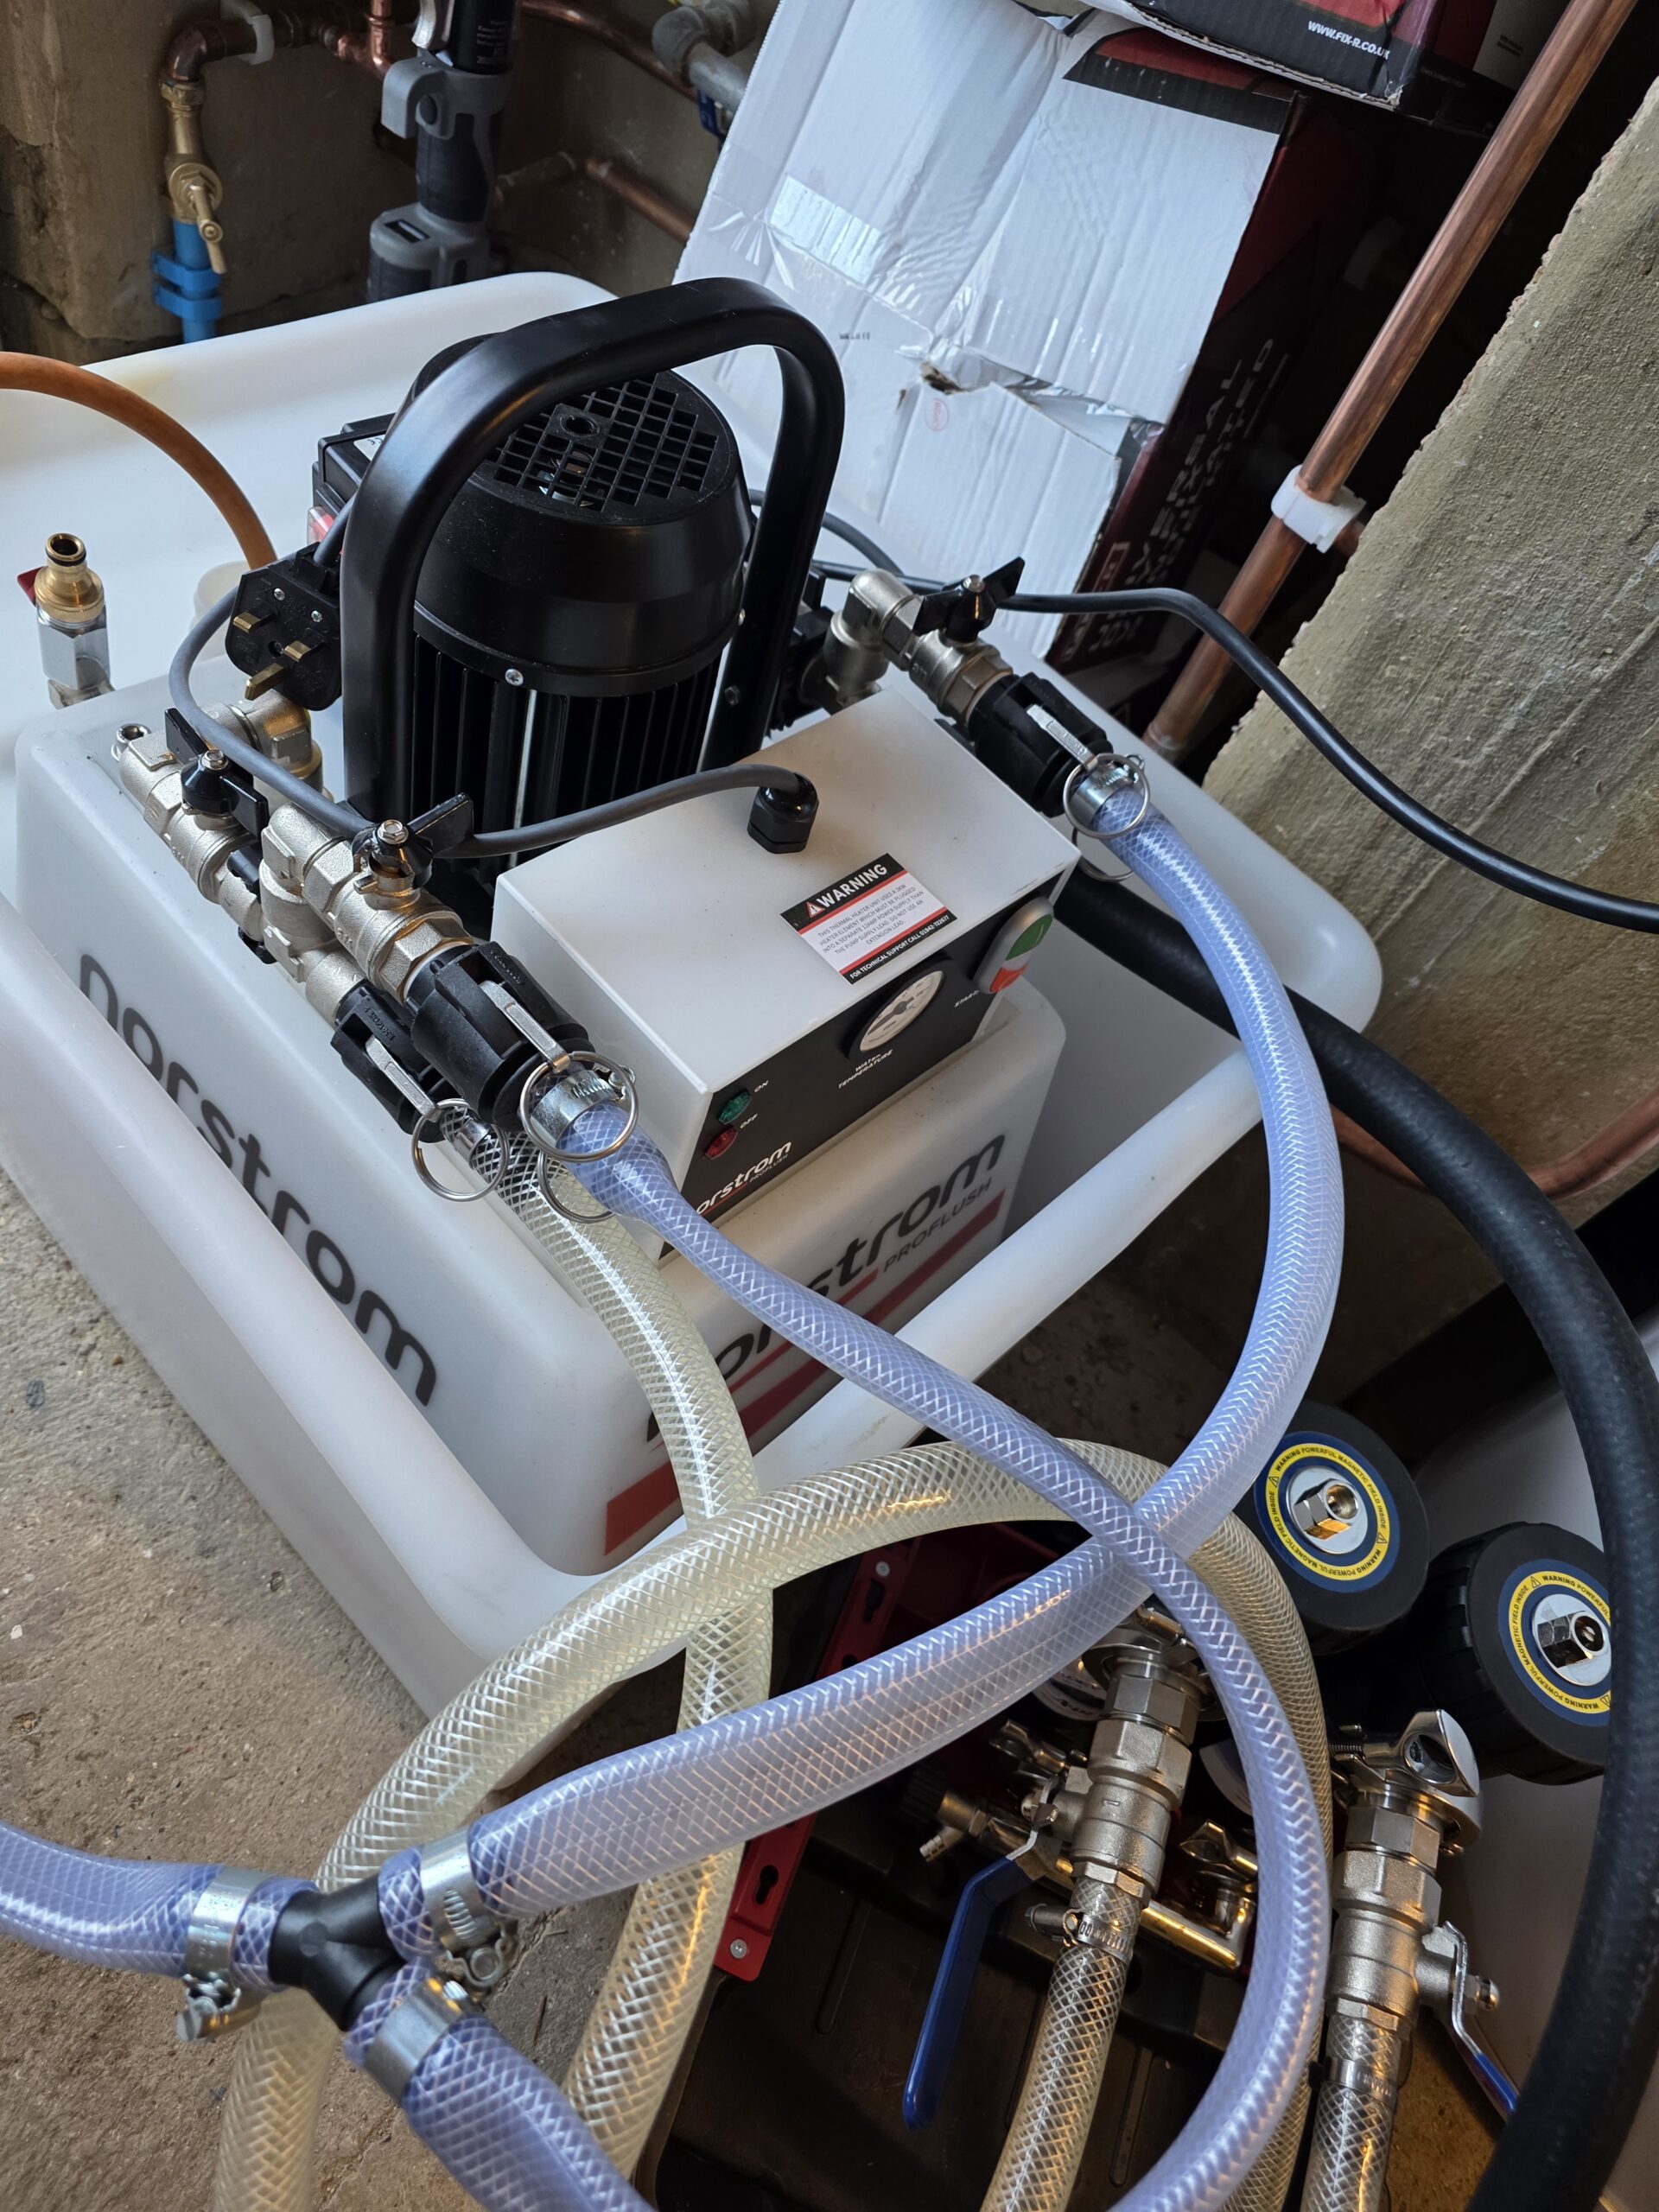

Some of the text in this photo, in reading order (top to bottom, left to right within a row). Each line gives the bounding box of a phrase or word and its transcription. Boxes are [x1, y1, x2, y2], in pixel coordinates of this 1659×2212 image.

[1307, 21, 1390, 60] WWW.FIX-R.CO.UK
[1112, 338, 1277, 645] VNTILATED
[1100, 557, 1154, 649] DY
[817, 864, 887, 908] WARNING
[817, 928, 831, 938] THIS
[829, 915, 853, 931] THERMAL
[850, 905, 870, 918] HEATER
[868, 898, 881, 907] UNIT
[818, 931, 839, 945] HEATER
[837, 919, 860, 934] ELEMENT
[858, 910, 875, 922] WHICH
[874, 902, 888, 912] MUST
[893, 886, 916, 900] PLUGGED
[822, 943, 836, 952] INTO
[838, 926, 863, 943] SEPARATE
[876, 907, 894, 919] POWER
[893, 897, 912, 910] SUPPLY
[909, 890, 924, 899] THAN
[843, 938, 860, 948] PUMP
[858, 927, 877, 940] SUPPLY
[896, 908, 907, 917] NOT
[865, 926, 893, 944] EXTENSION
[849, 969, 861, 978] FOR
[859, 953, 887, 972] TECHNICAL
[886, 940, 909, 956] SUPPORT
[906, 932, 921, 943] CALL
[754, 1080, 769, 1092] ON
[838, 1049, 893, 1089] TEMPERATURE
[740, 1113, 759, 1128] OFF
[79, 953, 436, 1407] norstrom
[696, 1141, 791, 1215] orstrom
[883, 1177, 992, 1273] PROFLUSH
[1274, 1448, 1300, 1471] WARNING
[1301, 1446, 1337, 1459] POWERFUL
[1338, 1455, 1369, 1486] MAGNETIC
[1368, 1484, 1380, 1503] FIELD
[1268, 1491, 1382, 1577] WARNING POWERFUL MAGNETIC FIELD INSIDE
[1516, 1585, 1529, 1604] INSIDE
[1541, 1575, 1609, 1617] WARNING POWERFUL
[1512, 1626, 1530, 1666] MAGNETIC
[1529, 1667, 1563, 1700] POWERFUL
[1565, 1698, 1599, 1709] WARNING
